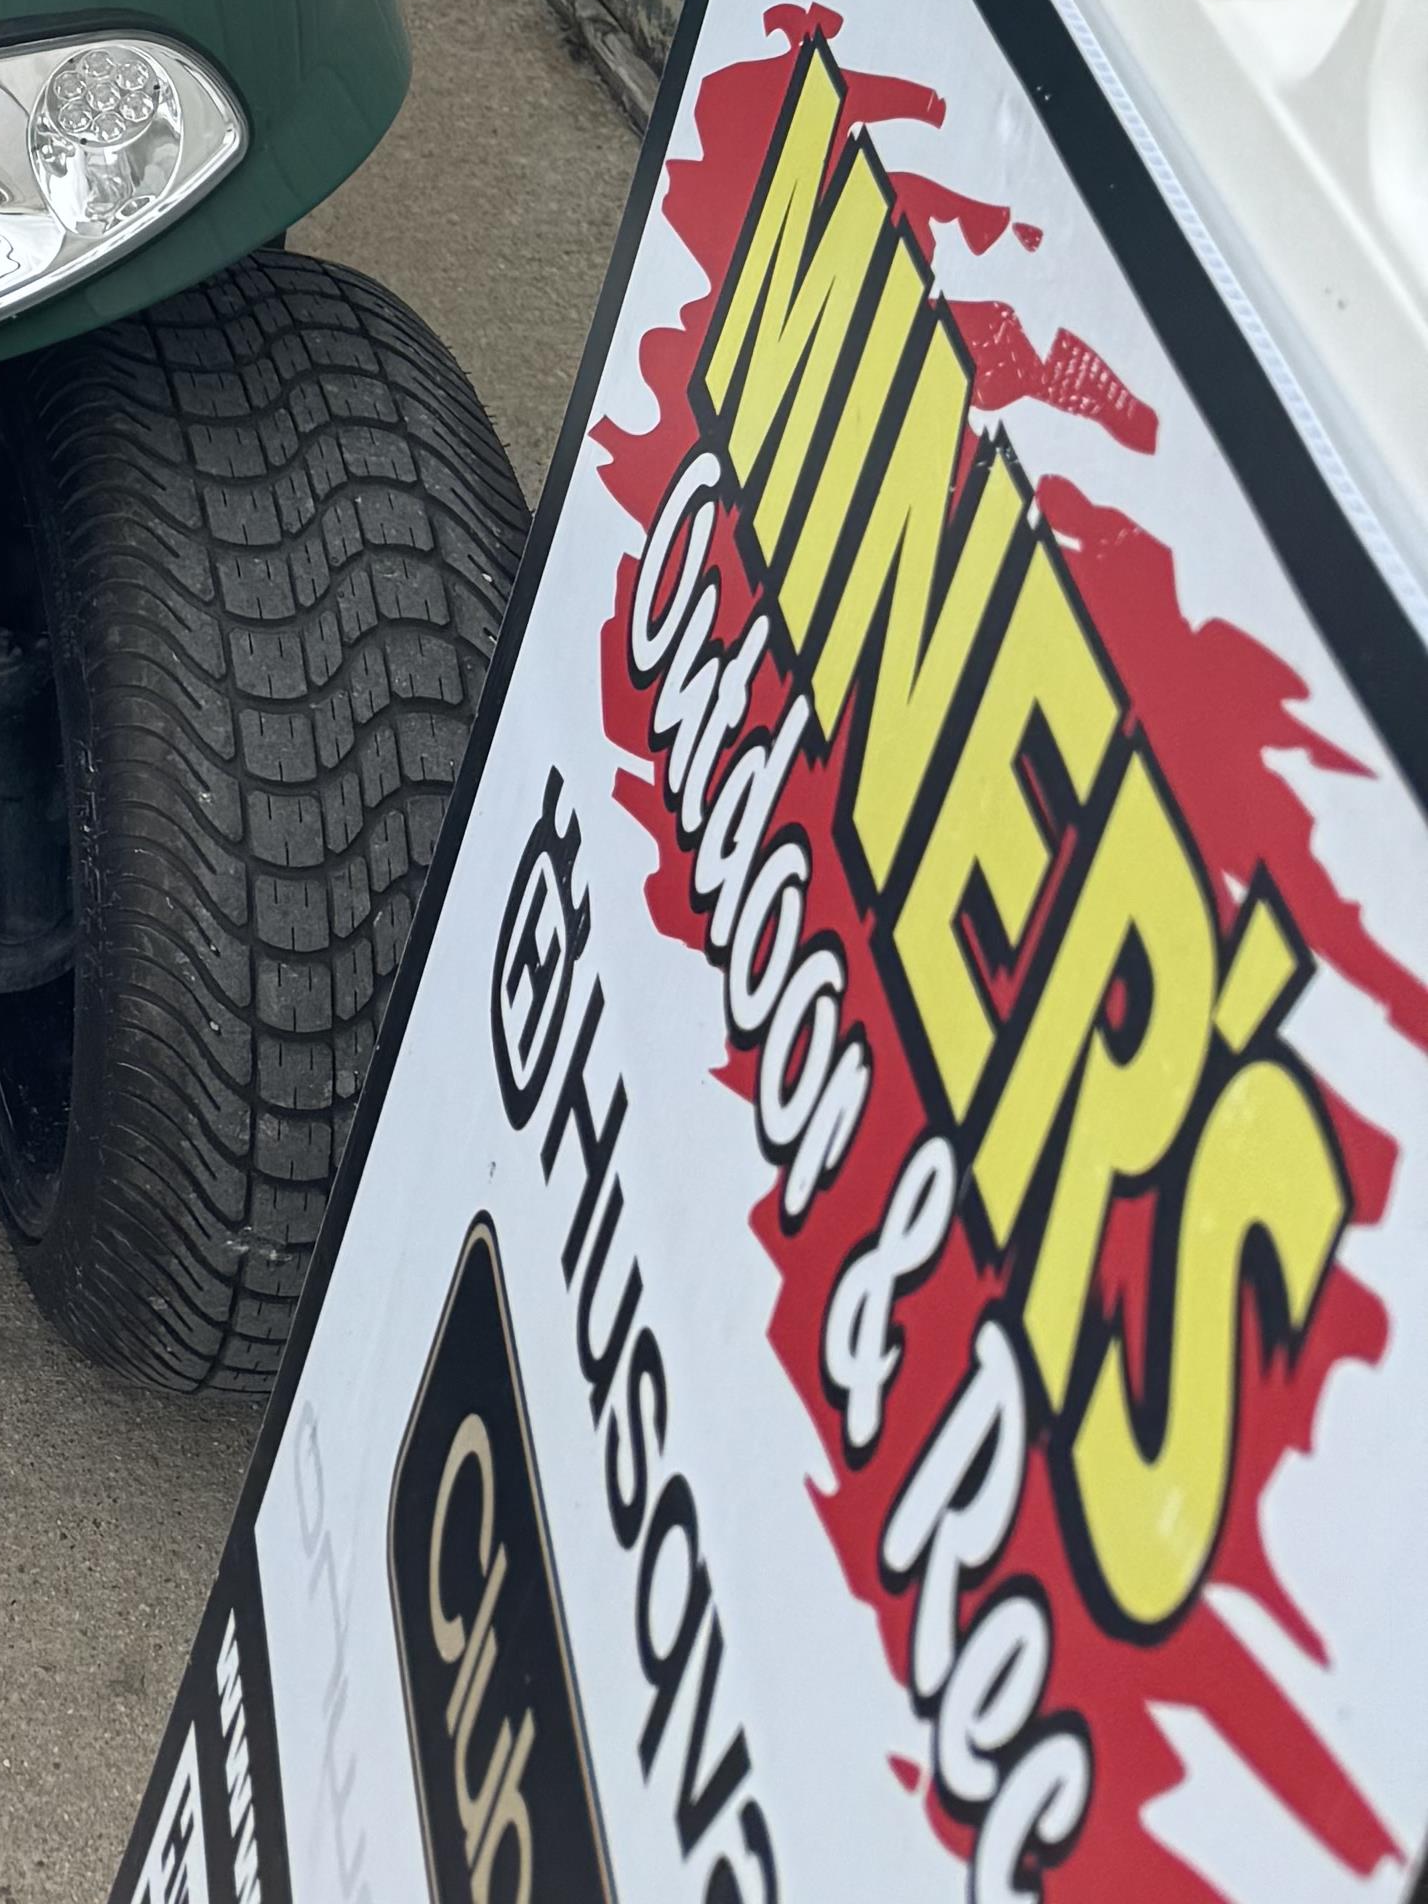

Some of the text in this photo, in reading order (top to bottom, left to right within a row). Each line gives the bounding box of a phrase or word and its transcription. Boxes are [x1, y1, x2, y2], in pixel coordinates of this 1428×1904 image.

[629, 449, 871, 1220] Outdoor
[825, 1135, 957, 1450] &
[696, 38, 1348, 1637] MINER'S
[429, 1412, 536, 1904] Club
